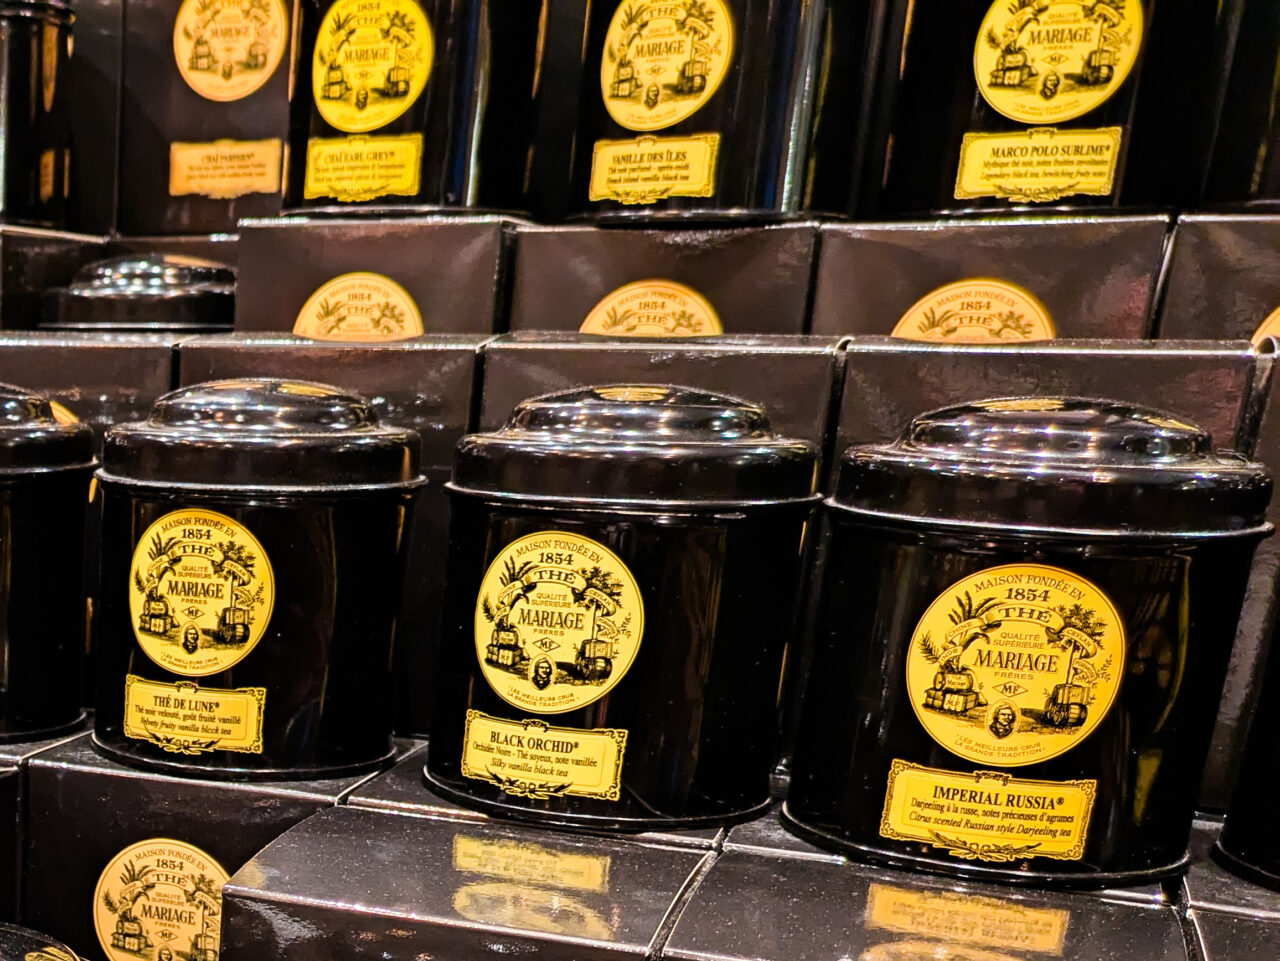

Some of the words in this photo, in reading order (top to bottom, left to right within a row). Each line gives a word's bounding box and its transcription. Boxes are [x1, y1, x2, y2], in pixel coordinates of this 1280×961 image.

[1027, 27, 1093, 46] MARIAGE
[342, 48, 390, 64] MARIAGE
[634, 40, 685, 59] MARIAGE
[612, 153, 645, 164] VANILLE
[647, 152, 663, 162] DES
[991, 147, 1028, 158] MARCO
[1030, 146, 1059, 157] POLO
[638, 301, 665, 310] 1854
[936, 291, 970, 307] MAISON
[960, 301, 992, 311] 1854
[182, 529, 212, 540] 1854
[516, 540, 551, 558] MAISON
[554, 540, 588, 556] FONDÉE
[589, 552, 603, 564] EN
[538, 552, 573, 565] 1854
[534, 569, 577, 584] THÉ
[167, 580, 224, 600] MARIAGE
[973, 574, 1022, 593] MAISON
[1026, 574, 1070, 593] FONDÉE
[1068, 588, 1086, 601] EN
[1004, 588, 1051, 602] 1854
[518, 608, 585, 630] MARIAGE
[998, 606, 1053, 623] THÉ
[1000, 631, 1040, 641] QUALITÉ
[973, 649, 1059, 673] MARIAGE
[1001, 684, 1020, 696] MF
[153, 694, 171, 708] THÉ
[174, 699, 186, 710] DE
[160, 720, 176, 731] fruity
[178, 723, 199, 732] vanilla
[201, 725, 219, 734] black
[490, 731, 524, 748] BLACK
[496, 745, 511, 757] Noire
[517, 749, 528, 759] Thé
[555, 756, 569, 764] note
[491, 758, 507, 769] Silky
[508, 761, 532, 773] vanilla
[534, 765, 554, 775] black
[556, 768, 568, 777] tea
[933, 785, 1002, 807] IMPERIAL
[911, 797, 945, 813] Darjeeling
[953, 804, 958, 813] la
[982, 809, 1000, 818] notes
[1002, 810, 1037, 823] précieuses
[909, 812, 932, 824] Citrus
[933, 815, 962, 828] scented
[963, 819, 994, 831] Russian
[996, 823, 1014, 834] style
[1016, 824, 1058, 839] Darjeeling
[1059, 829, 1072, 837] tea
[155, 858, 185, 871] 1854
[140, 904, 196, 925] MARIAGE
